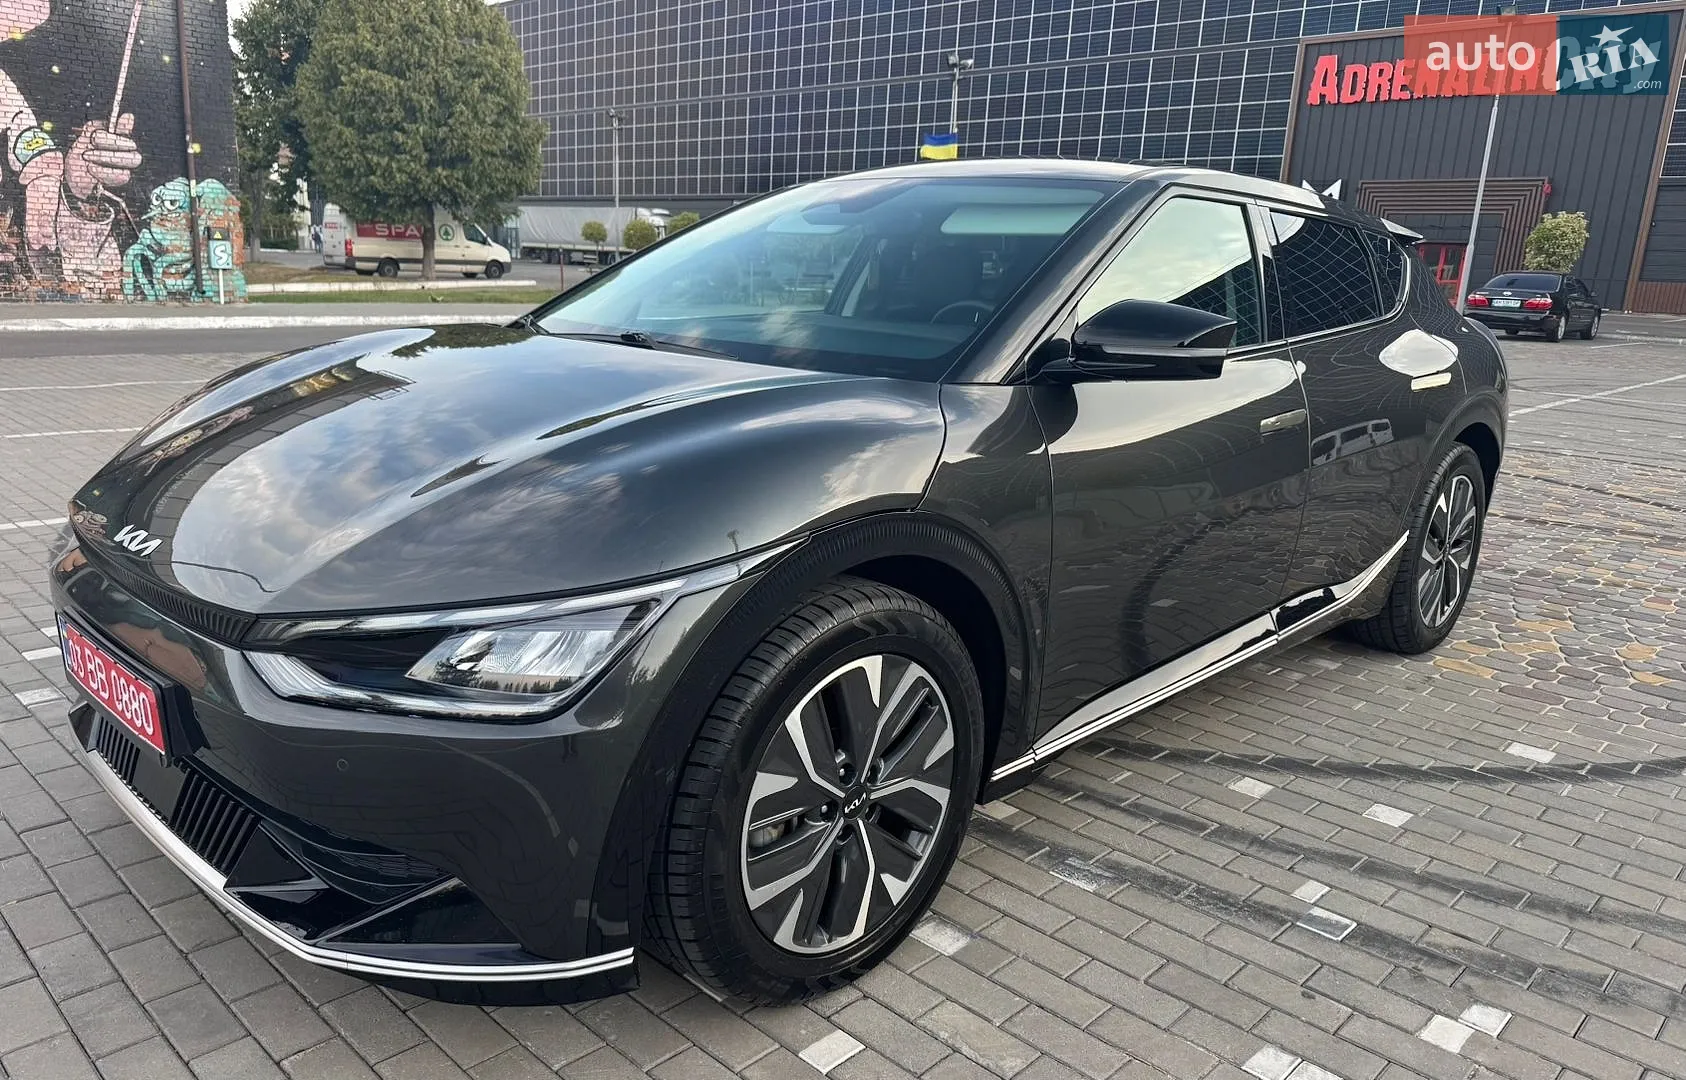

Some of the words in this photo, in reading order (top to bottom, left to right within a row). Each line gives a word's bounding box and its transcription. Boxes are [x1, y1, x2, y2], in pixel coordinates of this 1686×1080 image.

[375, 223, 424, 237] SPA
[69, 639, 84, 679] 03
[85, 647, 109, 700] BB
[111, 669, 154, 735] 0880
